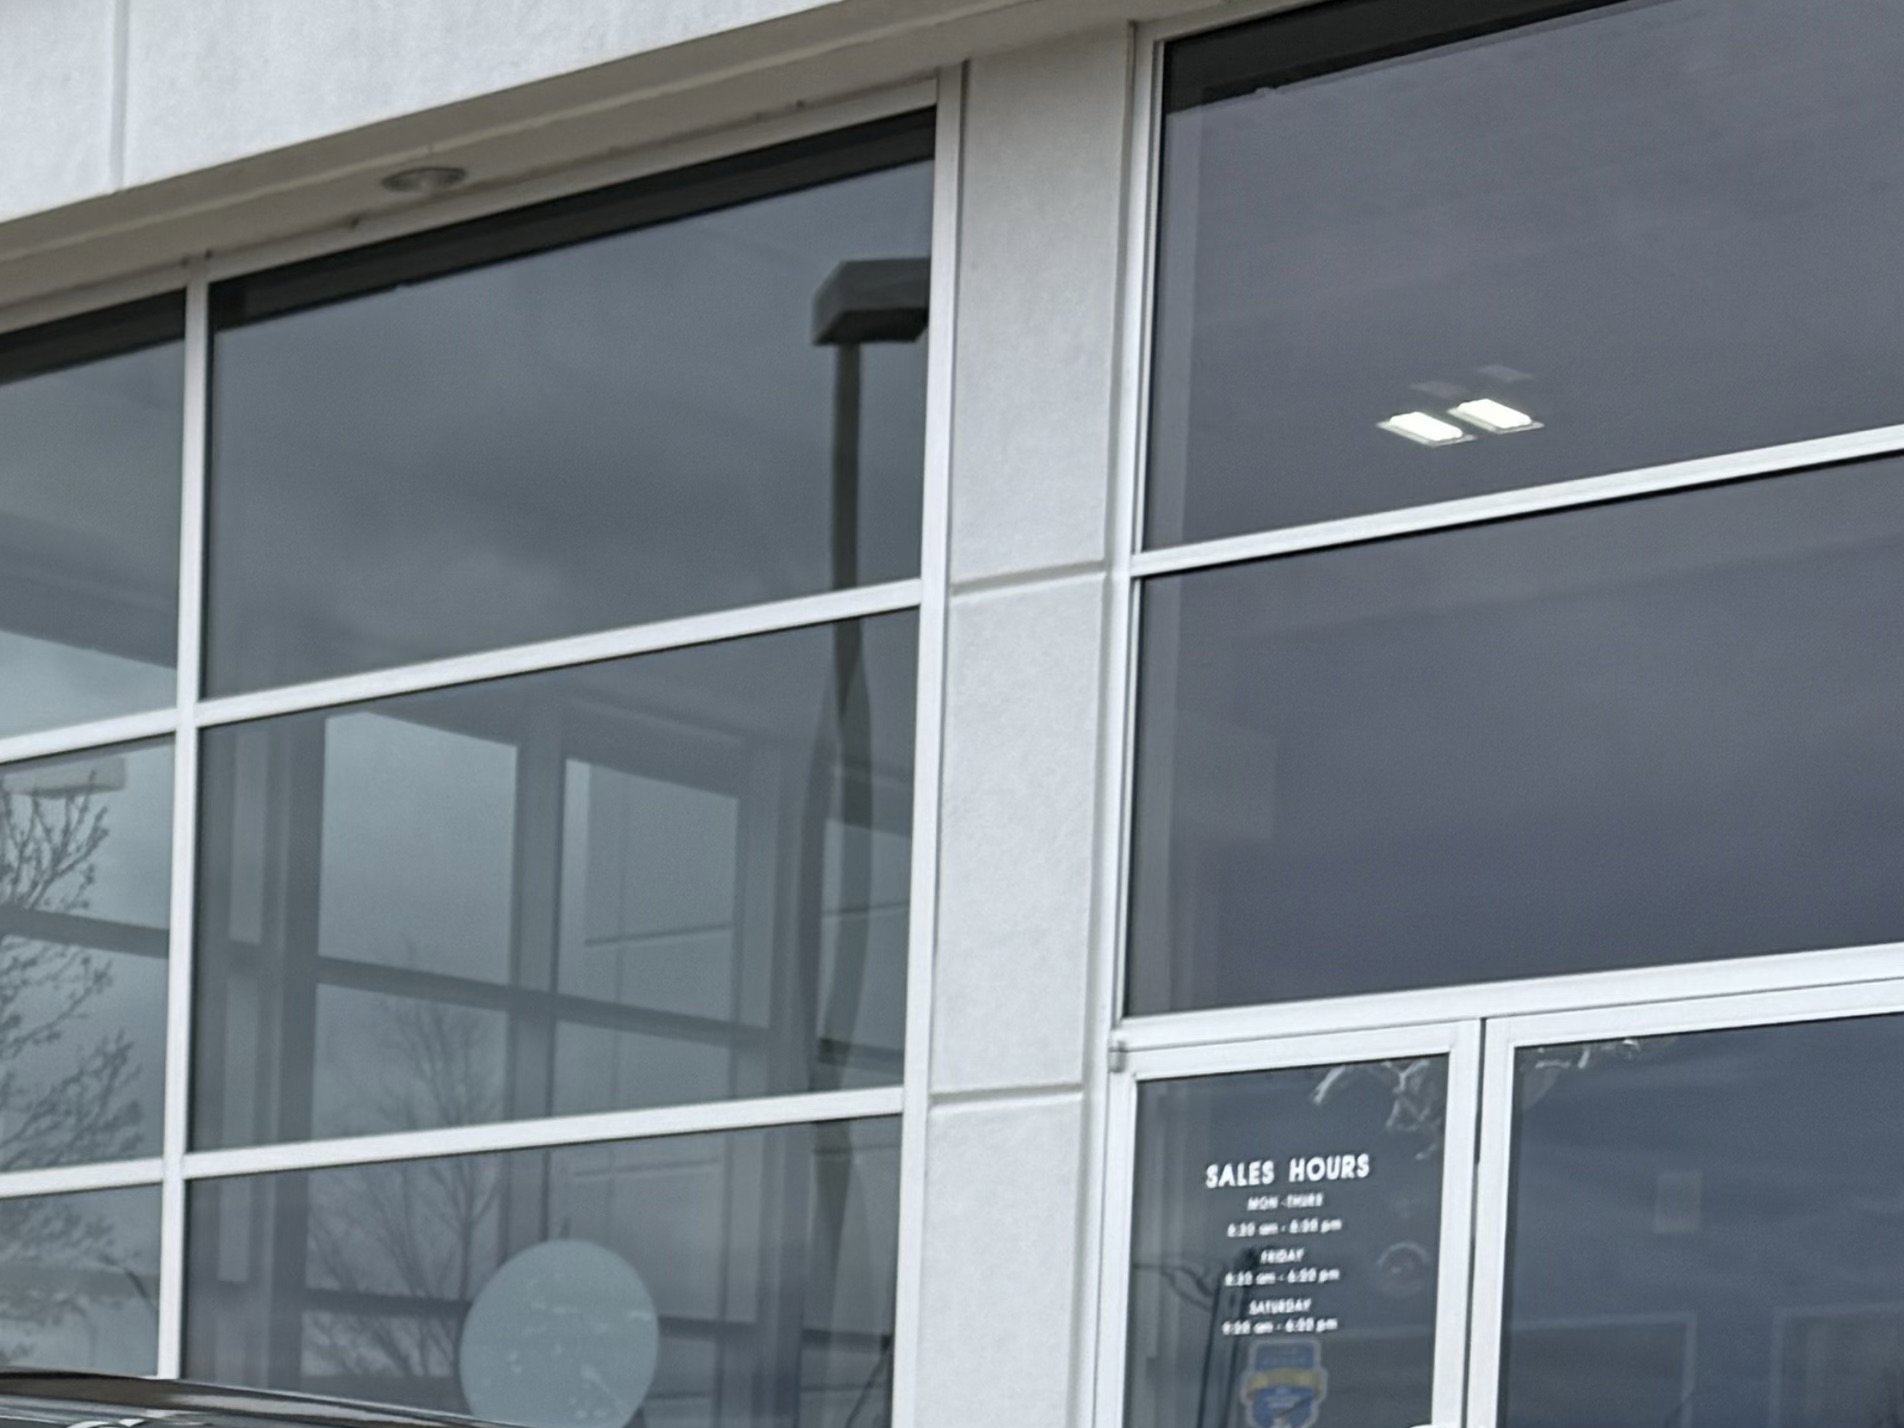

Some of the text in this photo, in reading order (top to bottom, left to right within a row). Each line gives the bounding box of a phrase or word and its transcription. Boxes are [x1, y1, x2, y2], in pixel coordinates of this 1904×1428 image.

[1205, 1153, 1370, 1188] SALES HOURS
[1320, 1219, 1342, 1233] pm
[1260, 1248, 1304, 1264] FRIDAY
[1318, 1269, 1340, 1283] pm
[1249, 1298, 1311, 1315] SATURDAY
[1316, 1319, 1338, 1332] pm
